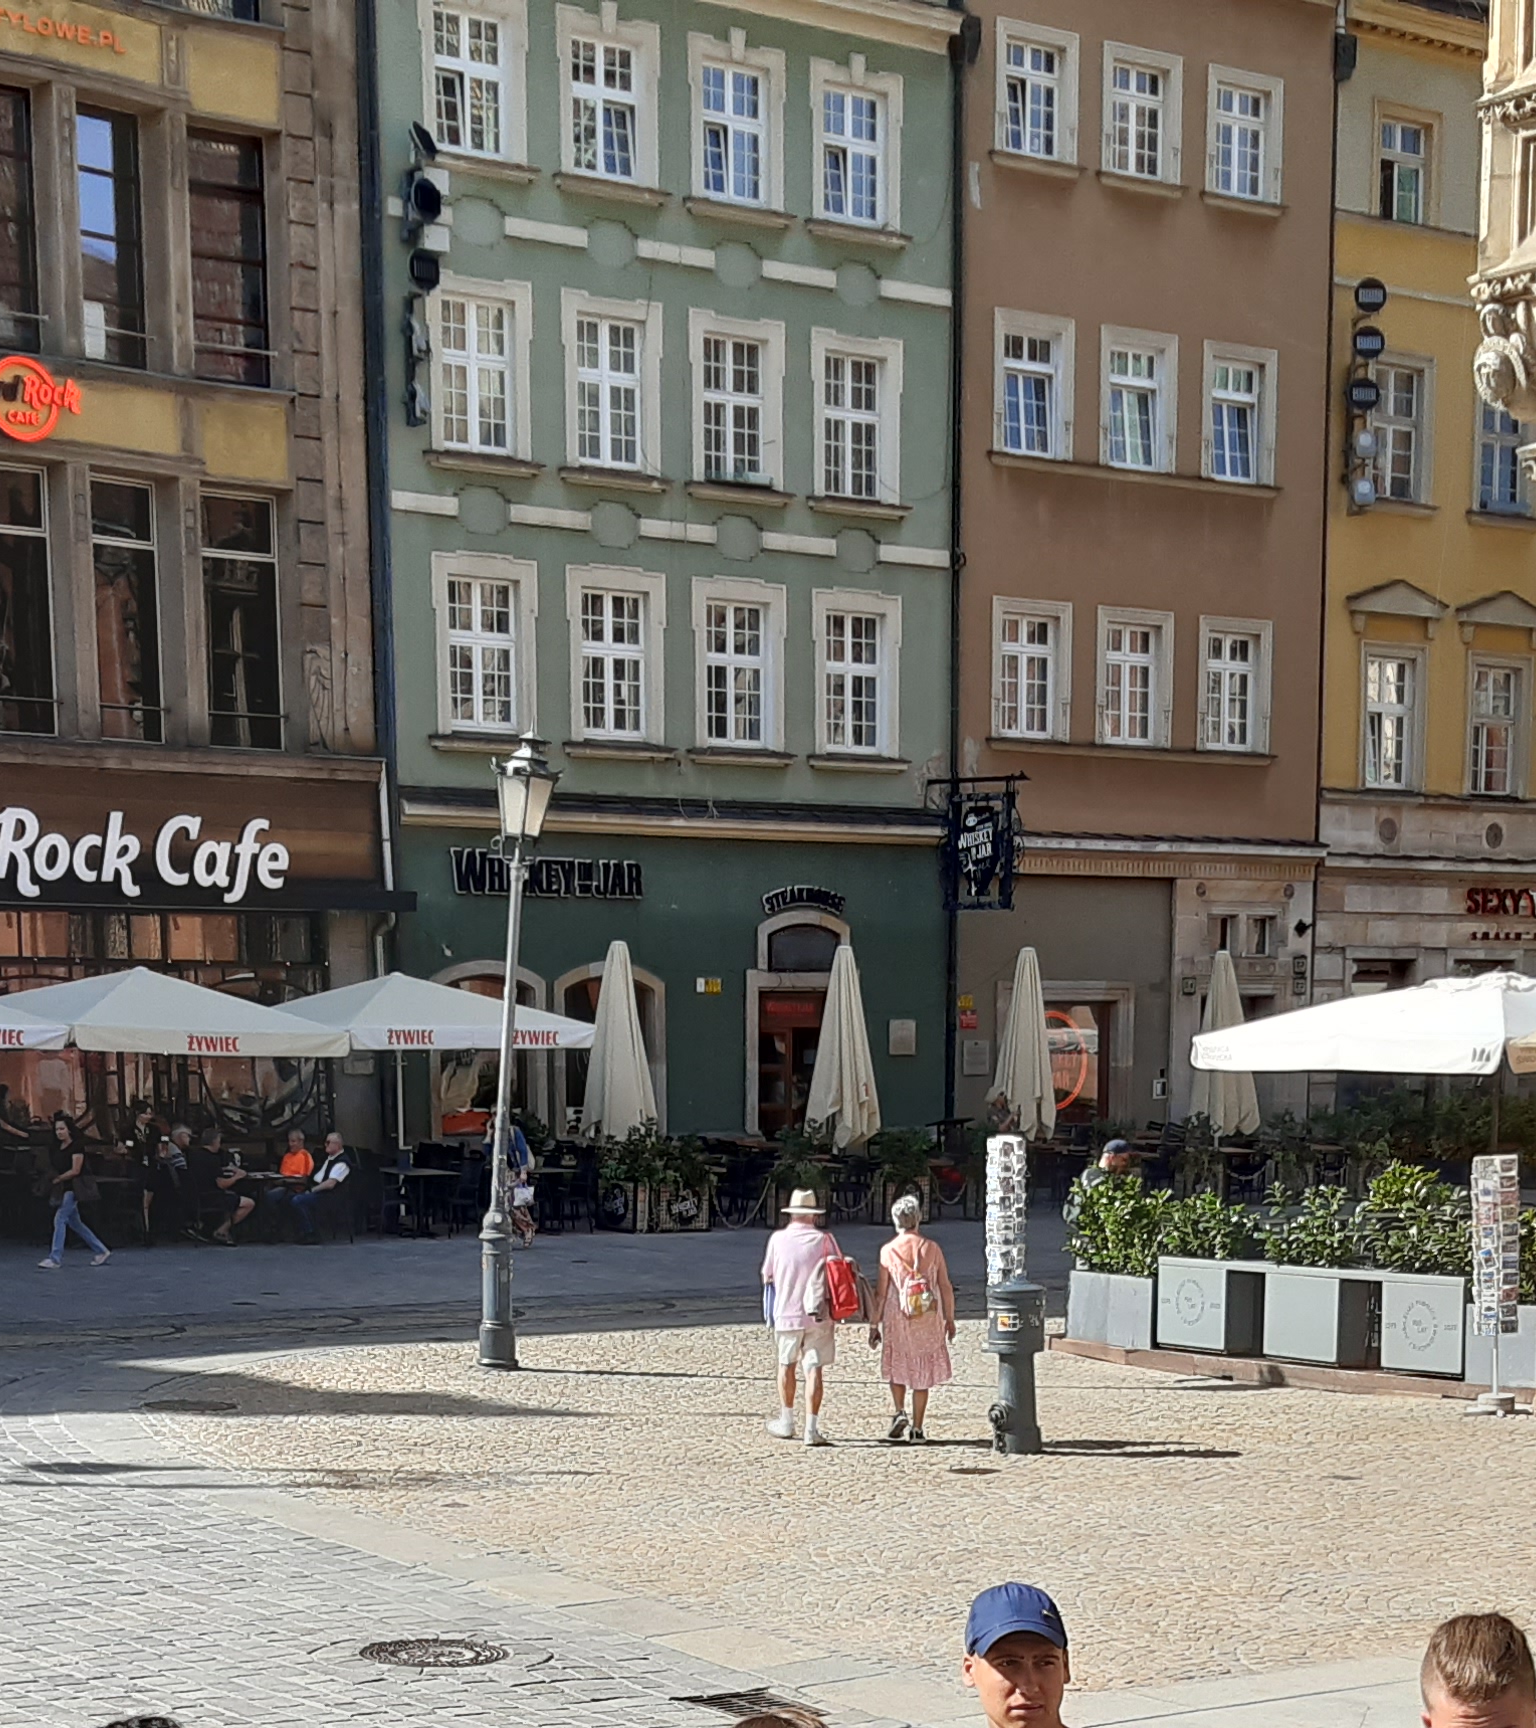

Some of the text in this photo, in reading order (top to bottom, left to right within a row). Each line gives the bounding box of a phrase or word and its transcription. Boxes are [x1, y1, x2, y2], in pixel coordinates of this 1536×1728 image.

[154, 814, 291, 904] Cafe
[186, 1033, 240, 1053] ŻYWIEC
[387, 1029, 435, 1046] ŻYWIEC
[512, 1029, 559, 1047] ŻYWIEC
